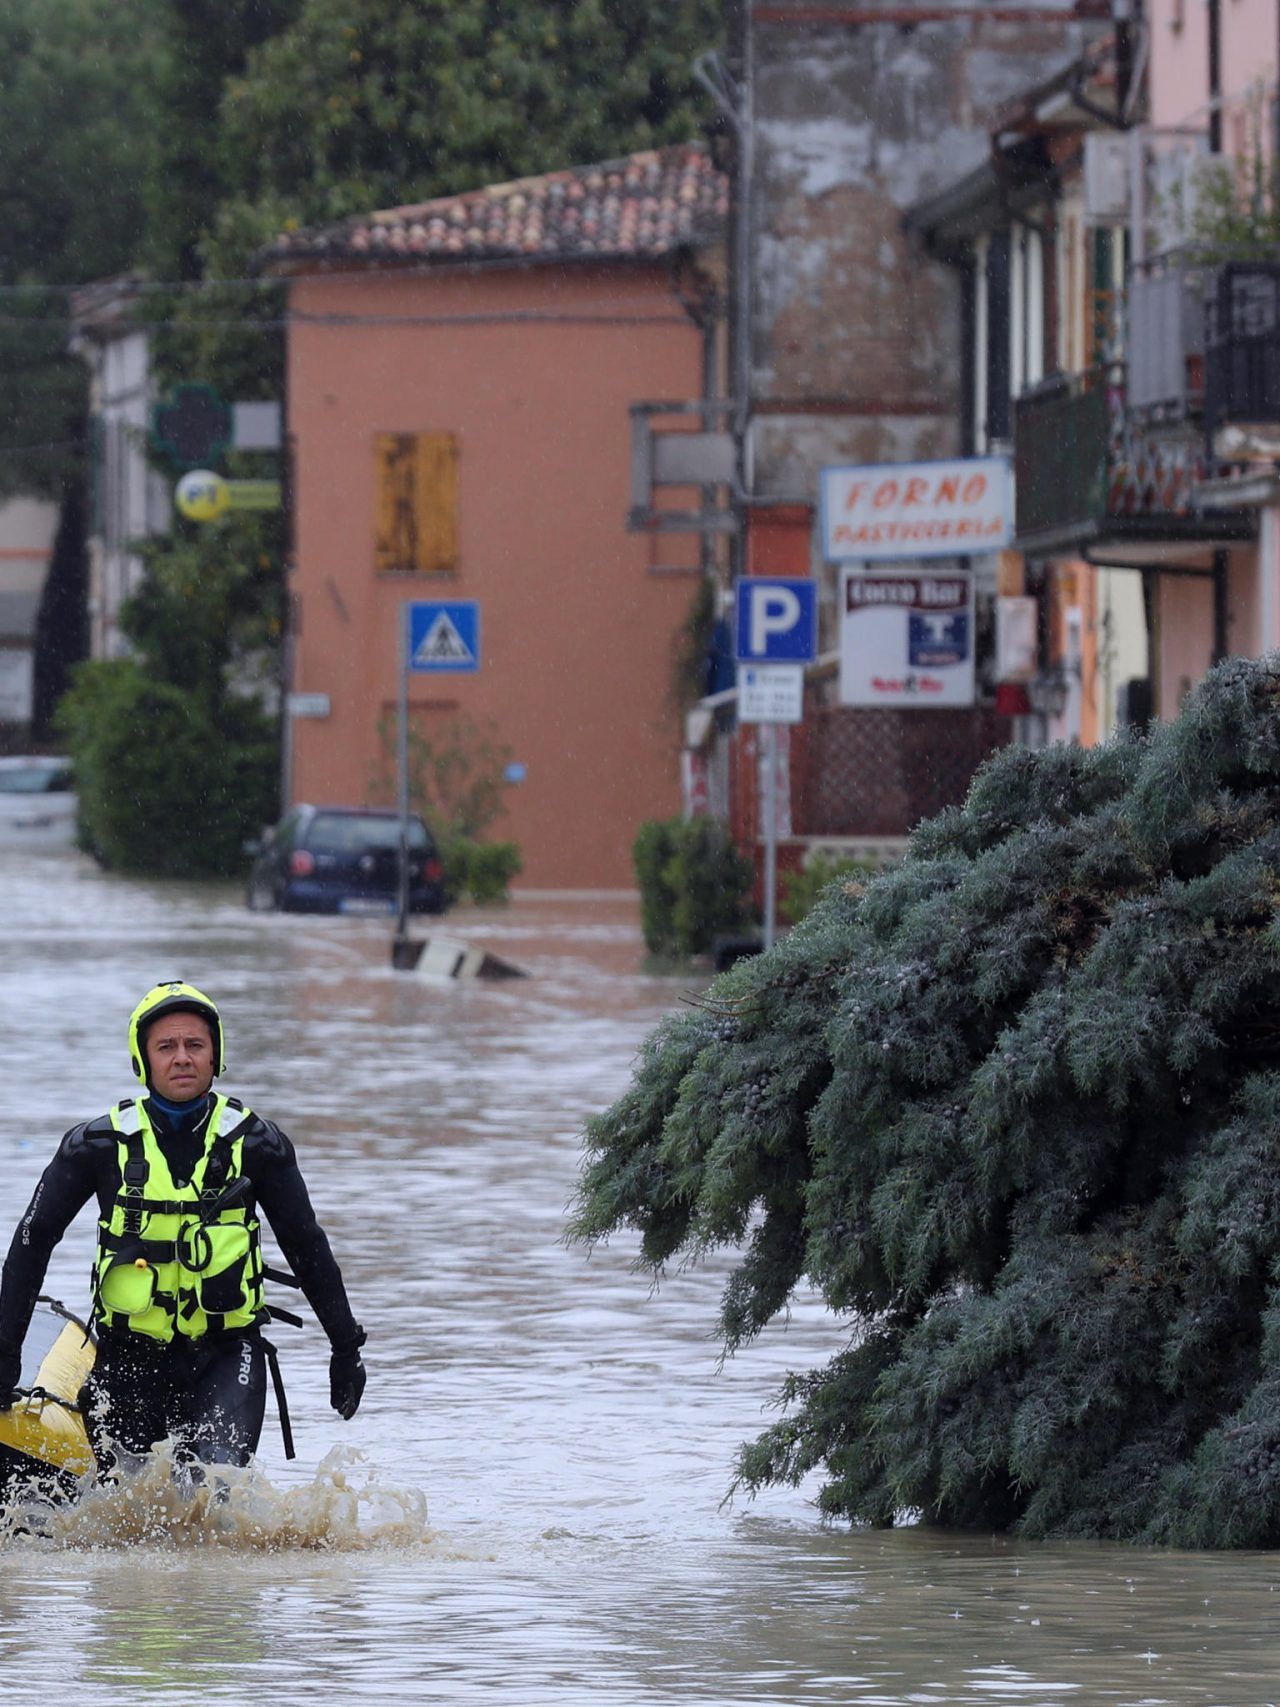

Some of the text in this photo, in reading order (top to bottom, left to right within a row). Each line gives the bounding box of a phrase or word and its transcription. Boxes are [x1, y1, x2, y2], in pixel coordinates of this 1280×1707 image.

[844, 474, 989, 513] FORNO
[833, 516, 1004, 544] PASTICCERIA
[751, 586, 801, 656] P
